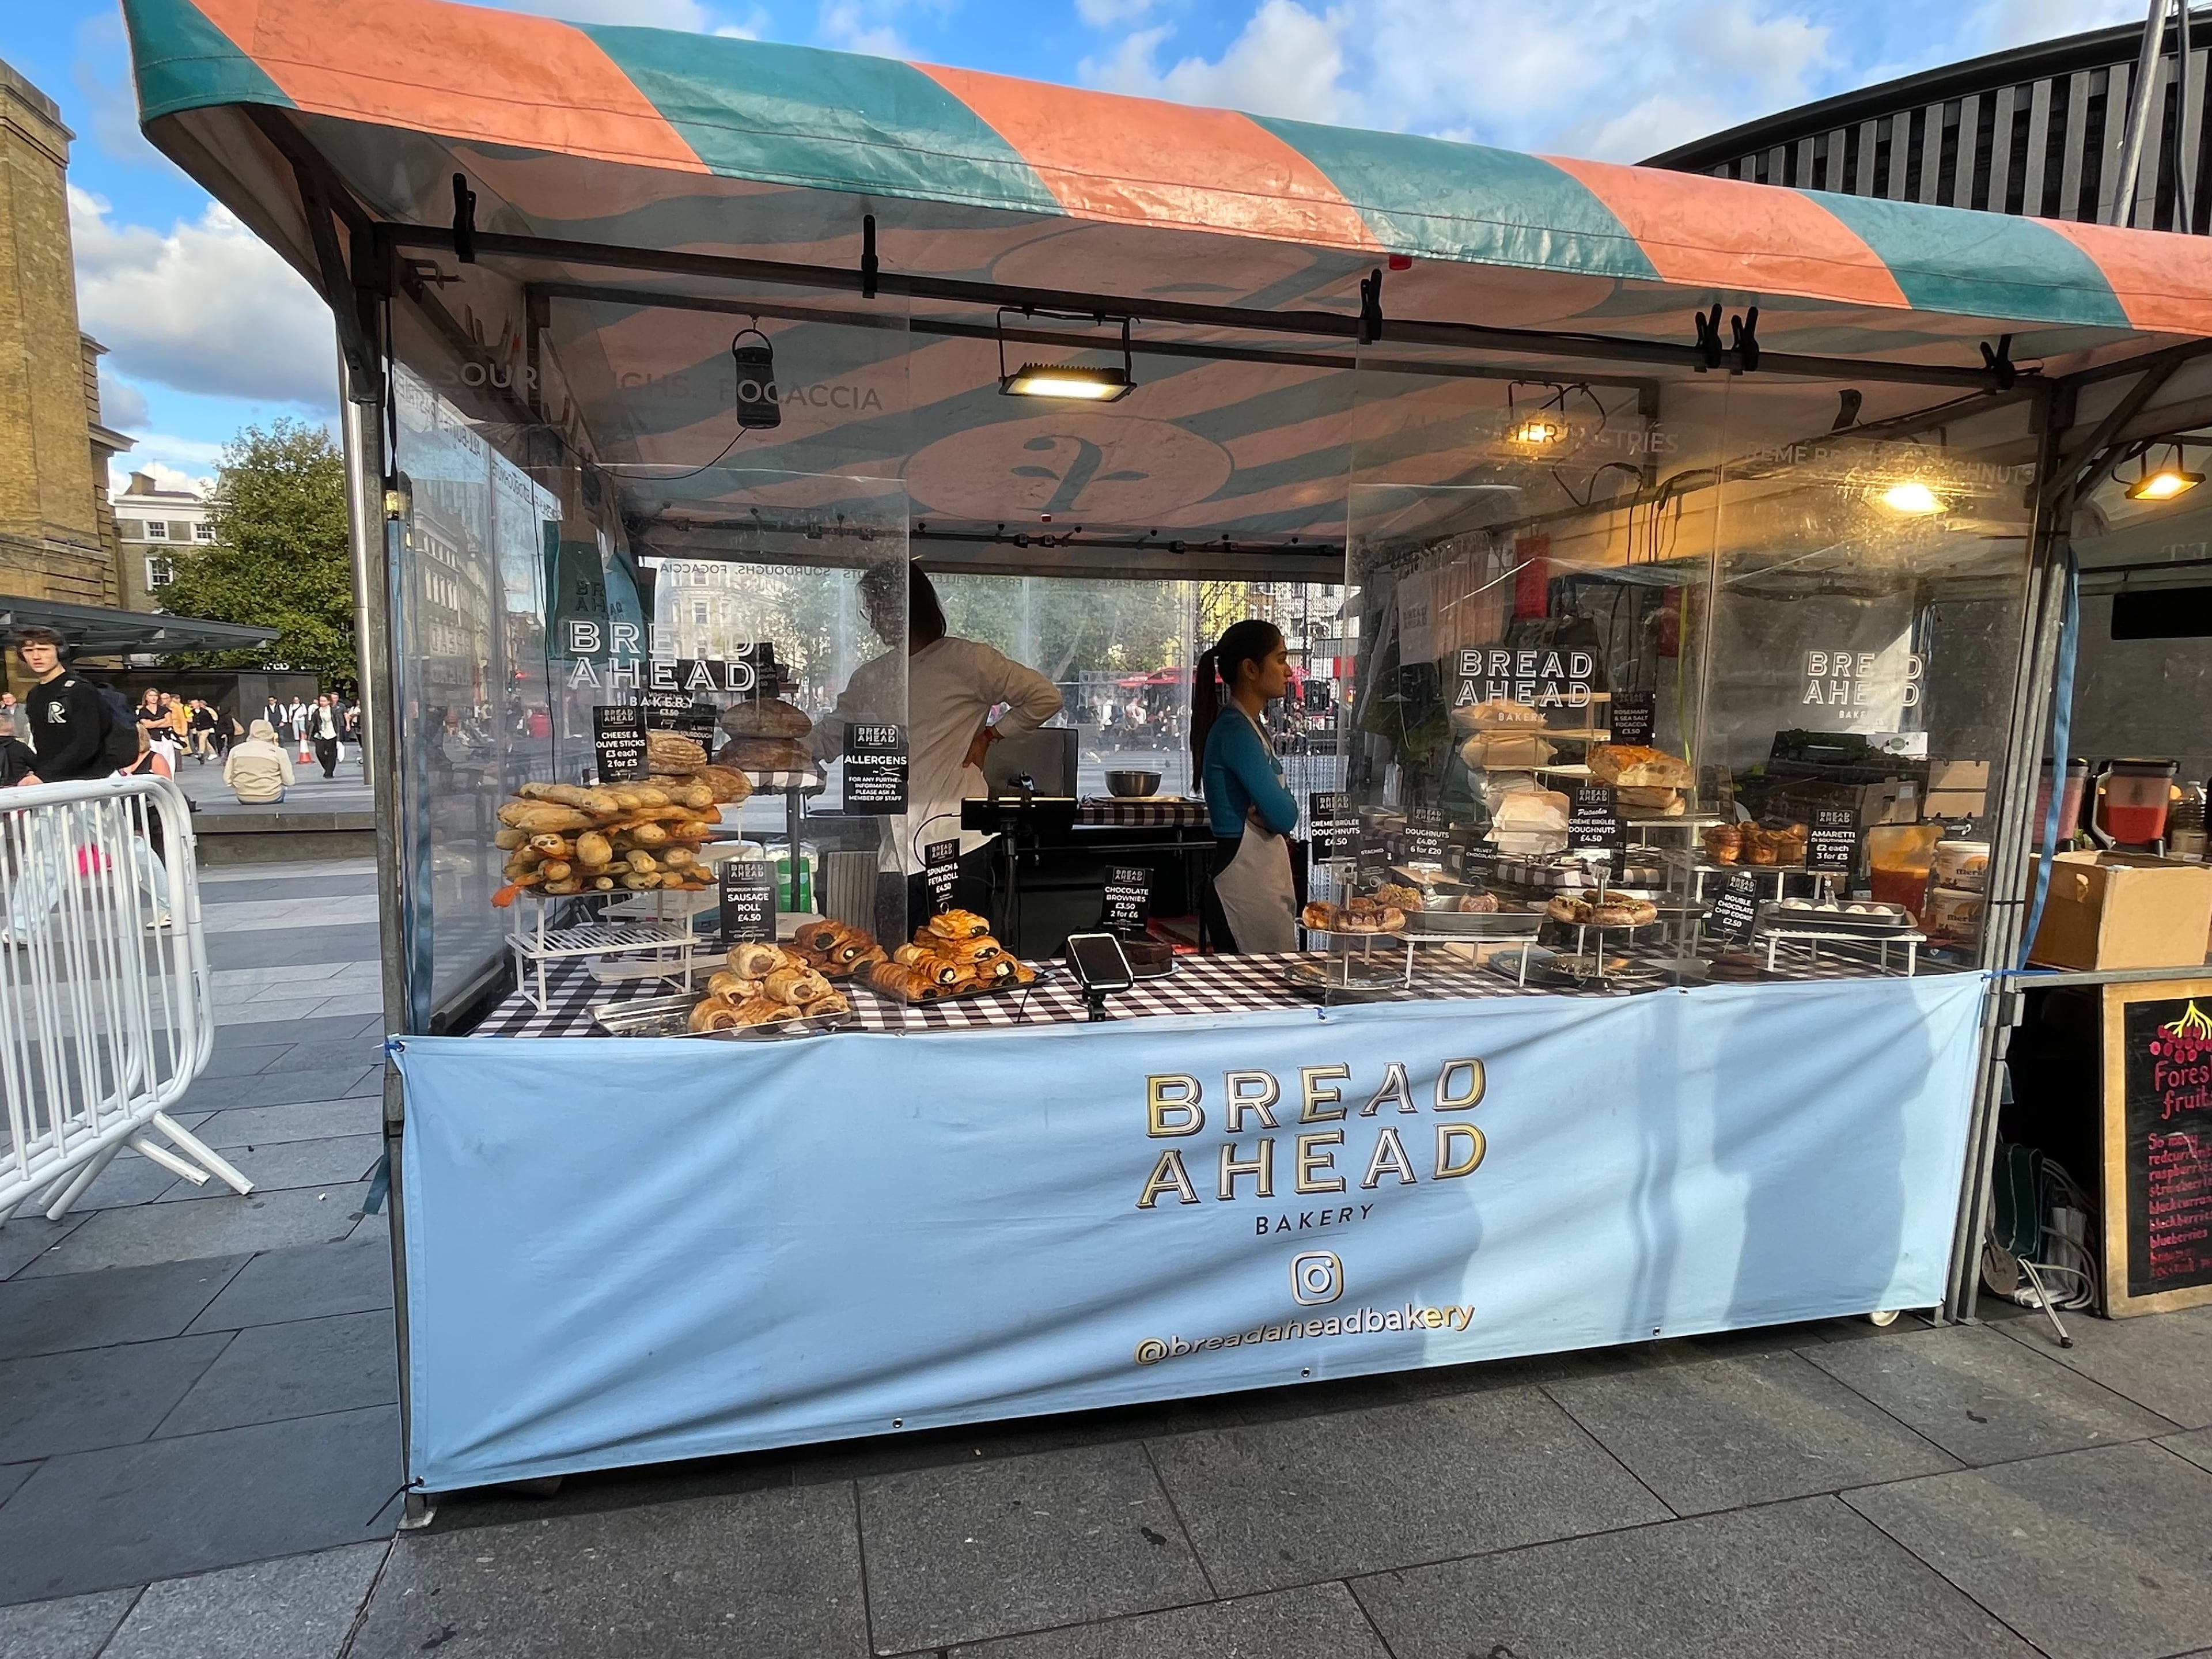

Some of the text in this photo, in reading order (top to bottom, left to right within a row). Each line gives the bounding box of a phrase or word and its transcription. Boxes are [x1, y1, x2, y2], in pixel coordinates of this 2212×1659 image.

[1459, 649, 1593, 679] BREAD
[1808, 651, 1922, 680] BRED
[567, 657, 756, 691] AHEAD
[1455, 679, 1592, 708] AHEAD
[1802, 680, 1920, 707] AHED
[630, 696, 694, 709] BAKERY
[1498, 712, 1547, 722] BAKERY
[617, 749, 637, 757] each
[627, 759, 638, 767] £5
[844, 755, 907, 765] ALLERGENS
[1312, 827, 1360, 836] DOUGHNUTS
[1406, 828, 1449, 838] DOUGHNUTS
[1416, 838, 1437, 846] £4.00
[927, 864, 953, 877] SPINACH
[928, 872, 959, 886] FETA ROLL
[728, 893, 769, 902] SAUSAGE
[1105, 887, 1149, 895] CHOCOLATE
[1725, 894, 1752, 906] DOUBLE
[1718, 900, 1754, 915] CHOCOLATE
[737, 914, 761, 922] £4.50
[1715, 907, 1753, 922] CHIP COOKIE
[1722, 917, 1742, 927] £2.50
[1145, 1056, 1487, 1138] BREAD
[2149, 1132, 2165, 1150] So
[1135, 1123, 1487, 1209] AHEAD
[1255, 1203, 1374, 1235] BAKERY
[1133, 1303, 1475, 1366] @breadaheadbakery
